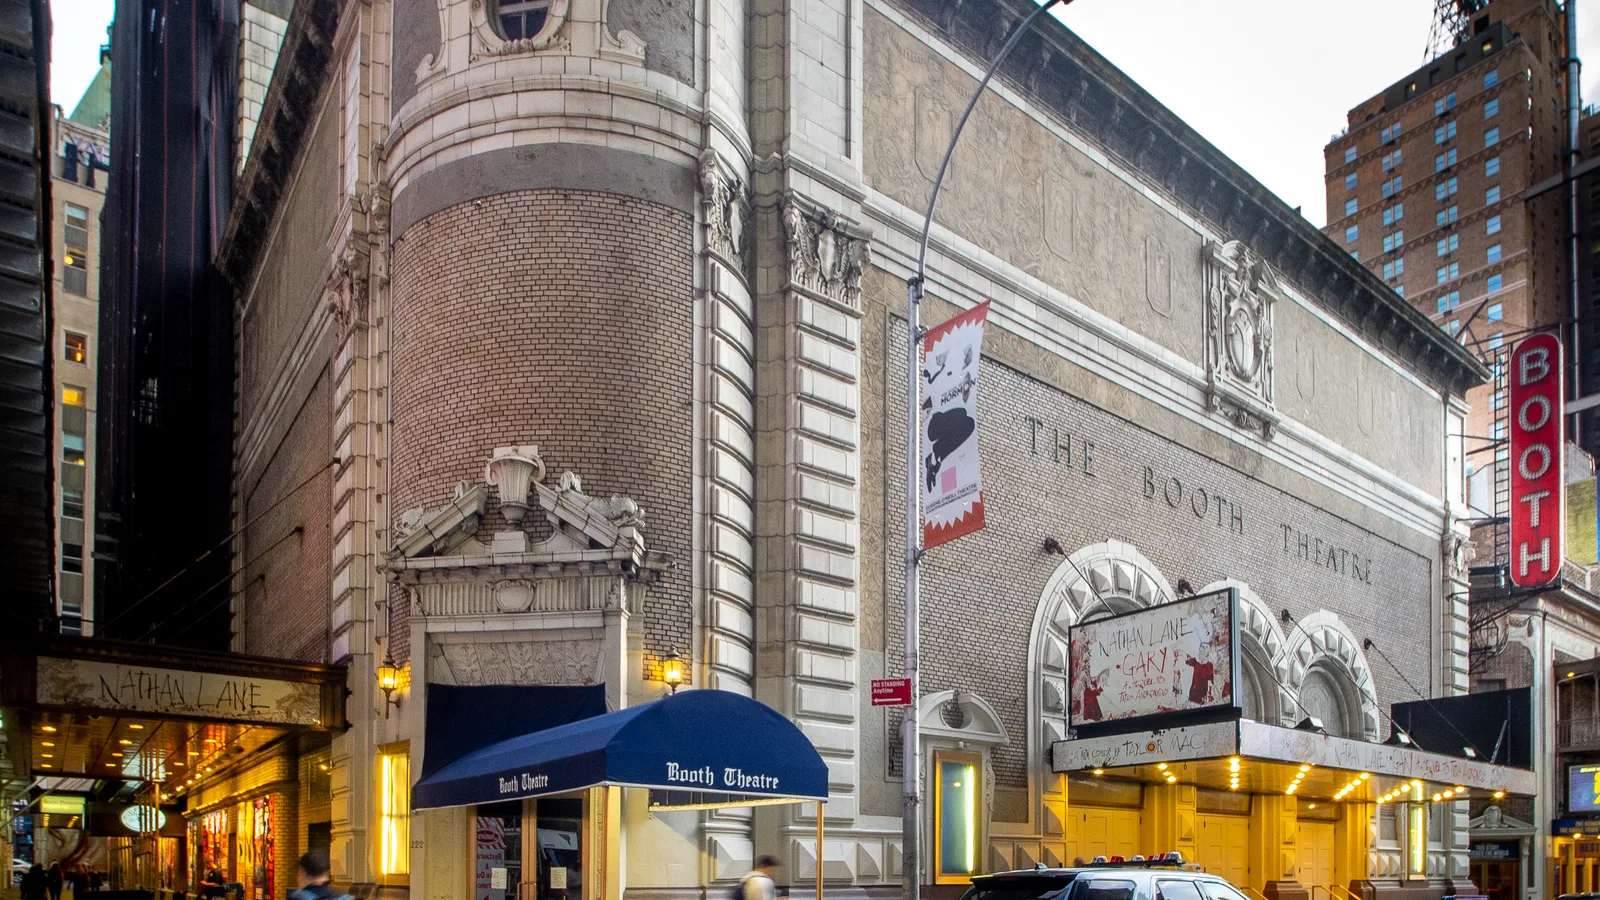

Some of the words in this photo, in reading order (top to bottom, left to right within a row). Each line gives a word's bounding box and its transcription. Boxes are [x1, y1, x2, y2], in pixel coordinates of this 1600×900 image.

[1518, 347, 1550, 577] BOOTH
[1025, 416, 1096, 477] THE
[1143, 466, 1243, 535] BOOTH
[1280, 523, 1372, 585] THEATRE
[1099, 625, 1144, 657] NATHAN
[1150, 617, 1193, 646] LANE
[1123, 647, 1167, 679] GARY
[99, 666, 186, 704] NATHAN
[196, 675, 270, 711] LANE
[1122, 740, 1163, 757] TAYLOR
[1172, 733, 1202, 754] MAC
[1335, 741, 1360, 767] NATHAN
[499, 775, 518, 793] Booth
[521, 773, 548, 791] Theatre
[666, 762, 714, 786] Booth
[723, 767, 779, 790] Theatre
[410, 840, 424, 848] 222
